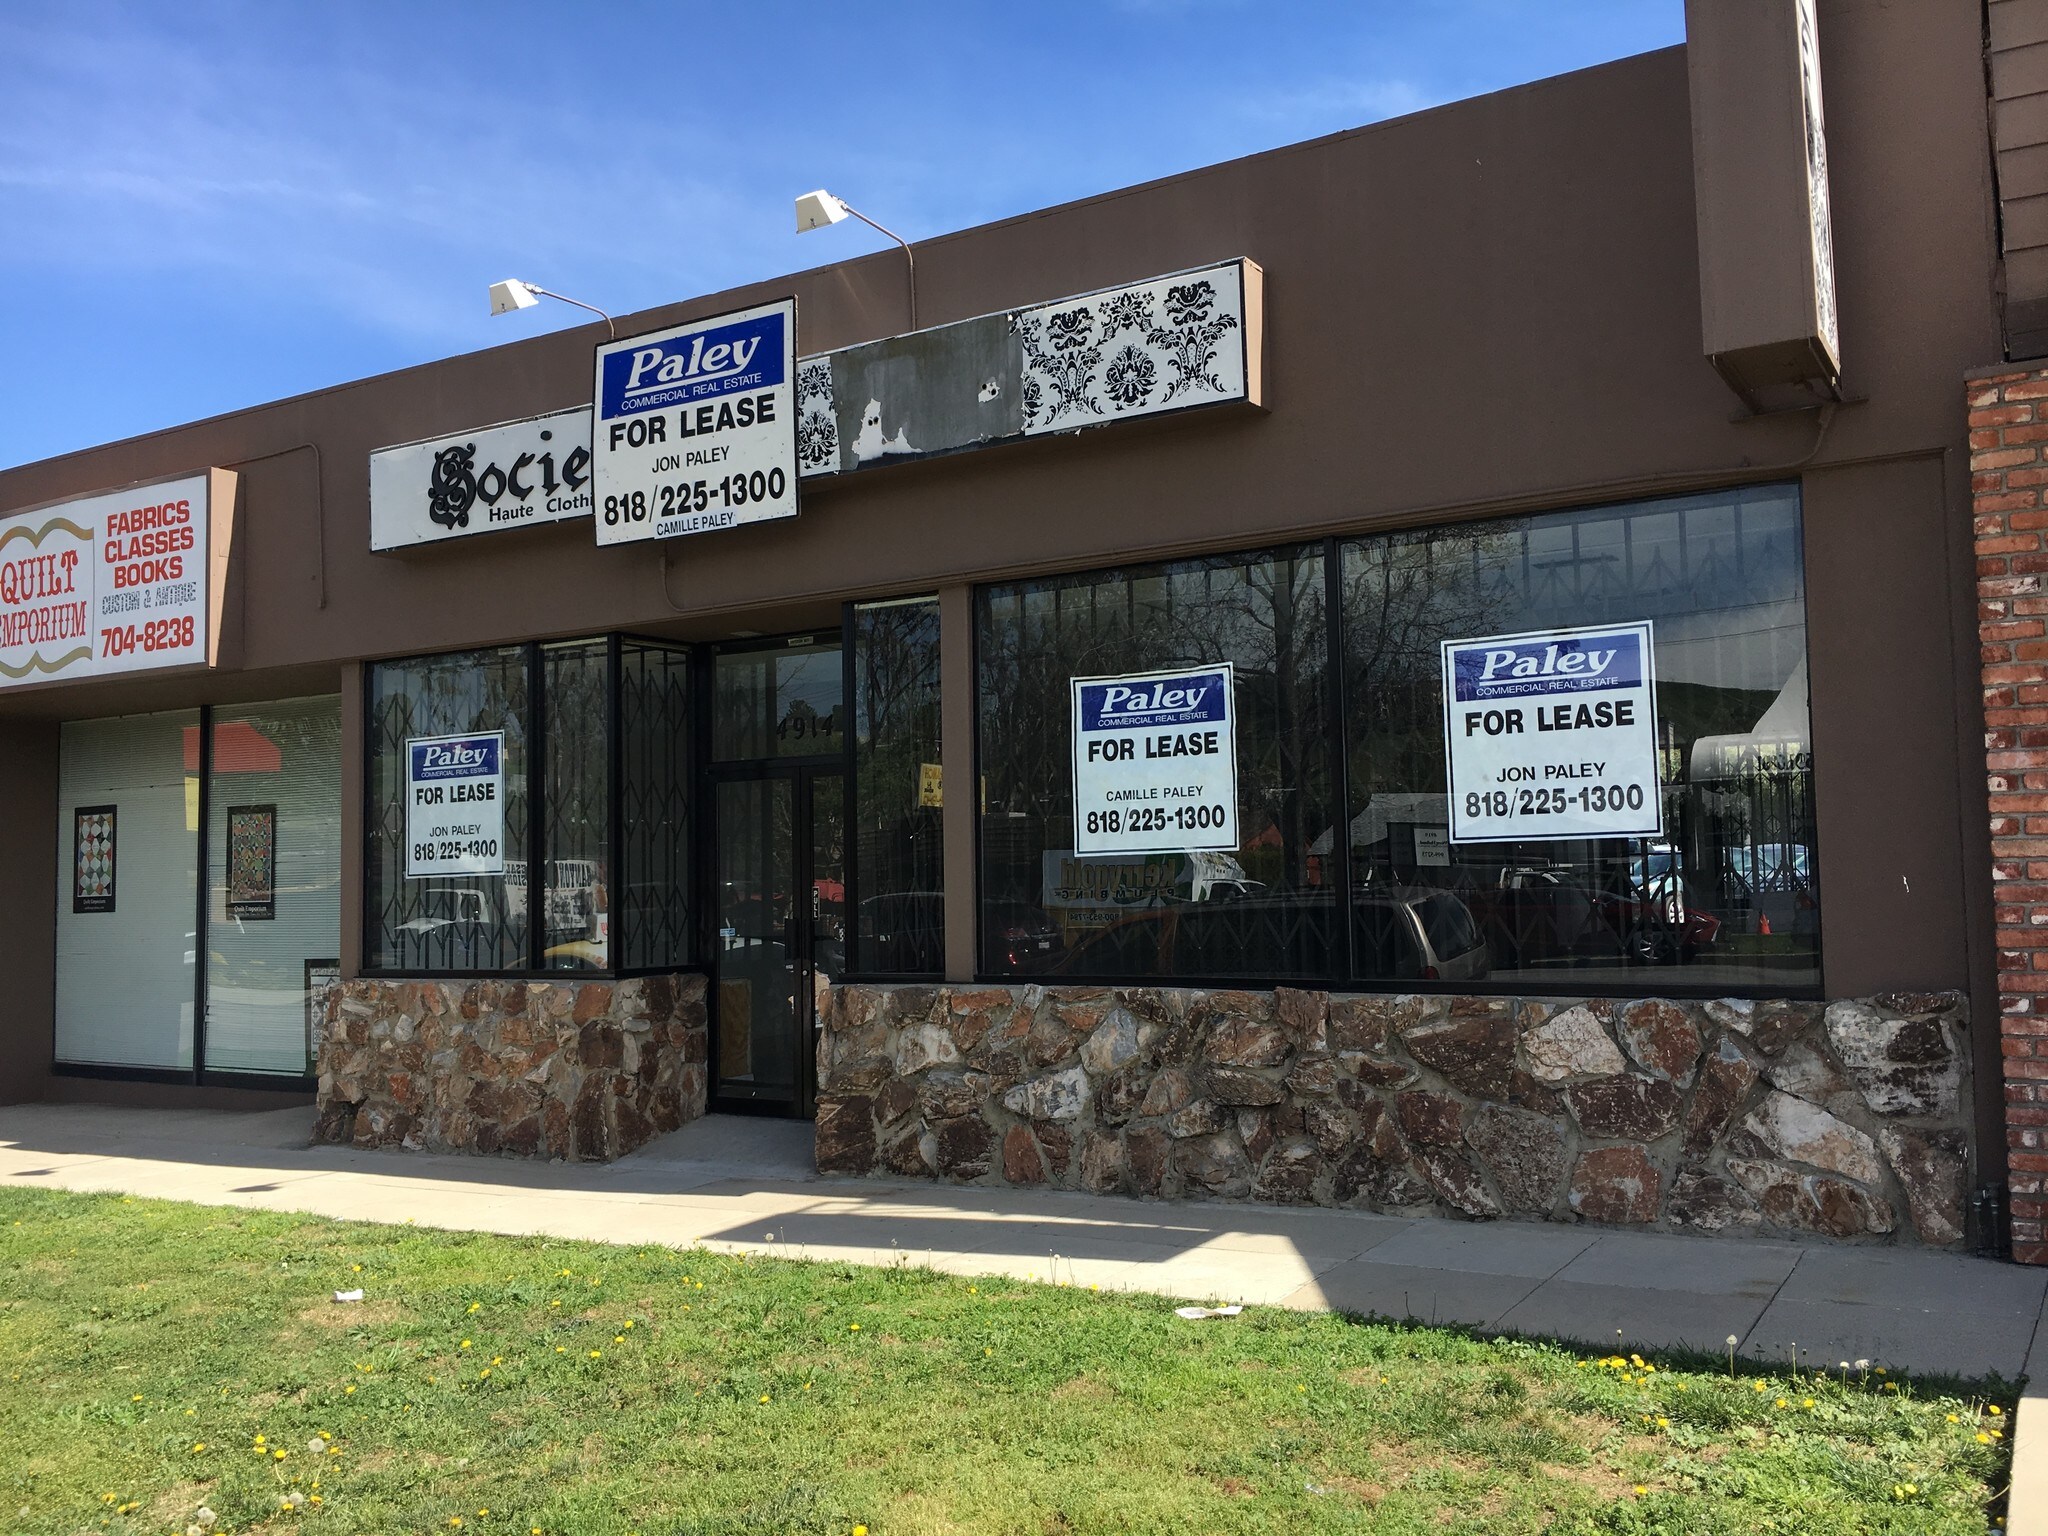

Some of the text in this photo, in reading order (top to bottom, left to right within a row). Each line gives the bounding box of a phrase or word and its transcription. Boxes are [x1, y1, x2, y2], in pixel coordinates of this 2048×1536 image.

[625, 336, 761, 391] Paley
[621, 373, 762, 411] COMMERCIAL REAL ESTATE
[609, 393, 776, 452] FOR LEASE
[652, 446, 730, 473] JON PALEY
[428, 430, 592, 531] Socie
[604, 467, 785, 526] 818/225-1300
[107, 500, 190, 537] FABRICS
[489, 502, 534, 523] Haute
[656, 512, 734, 536] CAMILLE PALEY
[104, 526, 194, 563] CLASSES
[0, 549, 79, 605] QUILT
[114, 555, 183, 589] BOOKS
[102, 582, 197, 615] CUSTOM & ANTIQUE
[0, 600, 87, 648] MPORIUM
[101, 615, 195, 658] 704-8238
[1479, 644, 1617, 680] Paley
[1100, 683, 1208, 713] Paley
[1476, 677, 1619, 696] COMMERCIAL REAL ESTATE
[776, 714, 833, 741] 4914
[1097, 711, 1208, 727] COMMERCIAL REAL ESTATE
[1465, 699, 1635, 737] FOR LEASE
[423, 744, 488, 767] Paley
[1088, 731, 1219, 763] FOR LEASE
[421, 766, 489, 778] COMMERCIAL REAL ESTATE
[1496, 762, 1606, 783] JON PALEY
[416, 782, 495, 806] FOR LEASE
[1106, 786, 1203, 802] CAMILLE PALEY
[1465, 783, 1644, 820] 818/225-1300
[429, 824, 481, 837] JON PALEY
[1087, 804, 1226, 835] 818/225-1300
[414, 839, 497, 863] 818/225-1300
